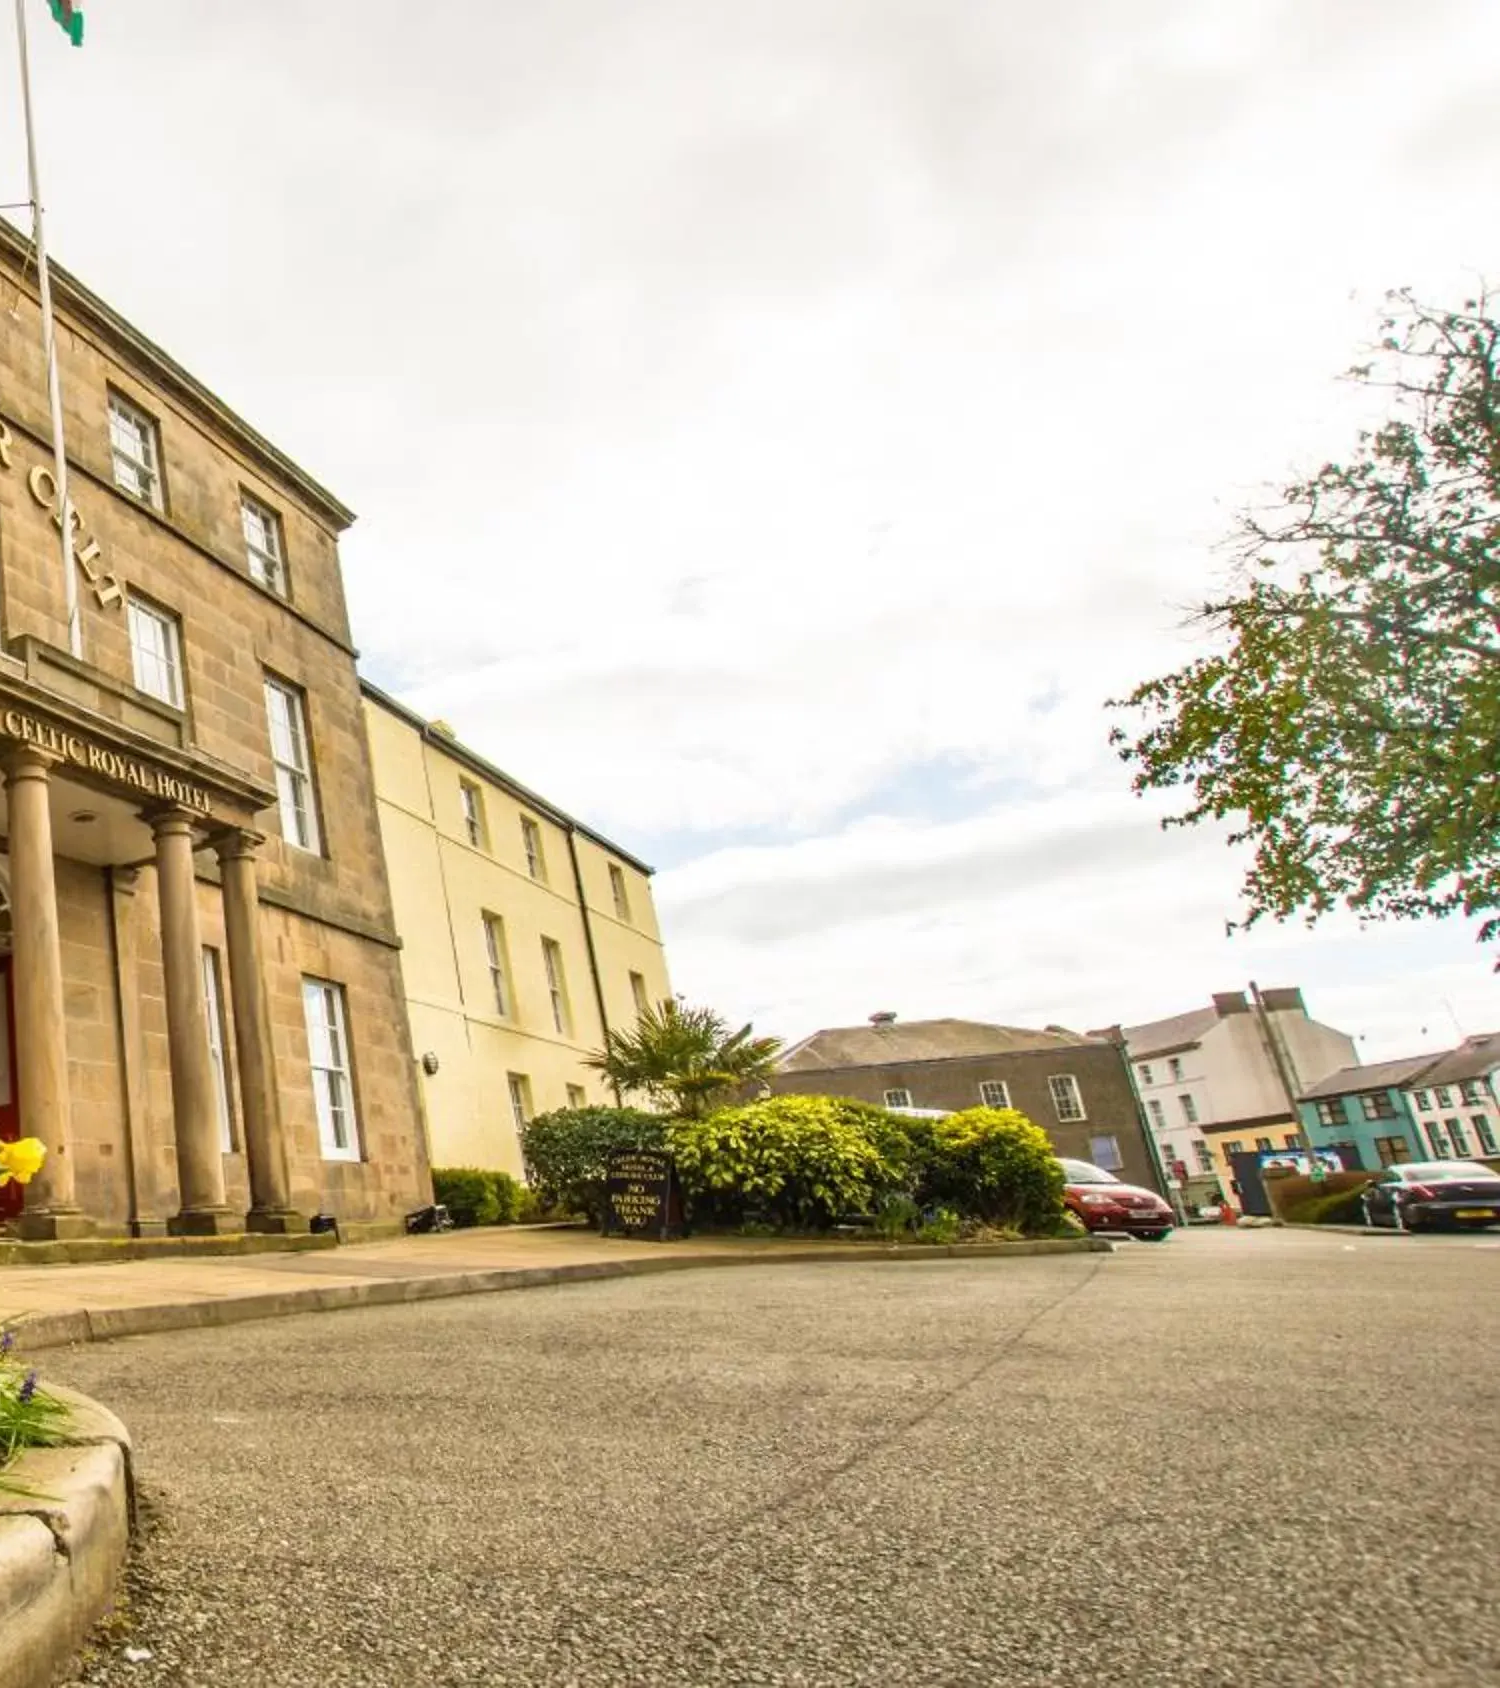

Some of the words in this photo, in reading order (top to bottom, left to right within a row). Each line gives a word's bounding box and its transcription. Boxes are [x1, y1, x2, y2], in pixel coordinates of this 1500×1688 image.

[5, 710, 88, 768] CELTIC
[89, 744, 155, 794] ROYAL
[156, 771, 211, 814] HOTEL
[628, 1183, 645, 1193] NO
[611, 1193, 661, 1205] PARKING
[614, 1204, 657, 1216] THANK
[623, 1215, 648, 1226] YOU
